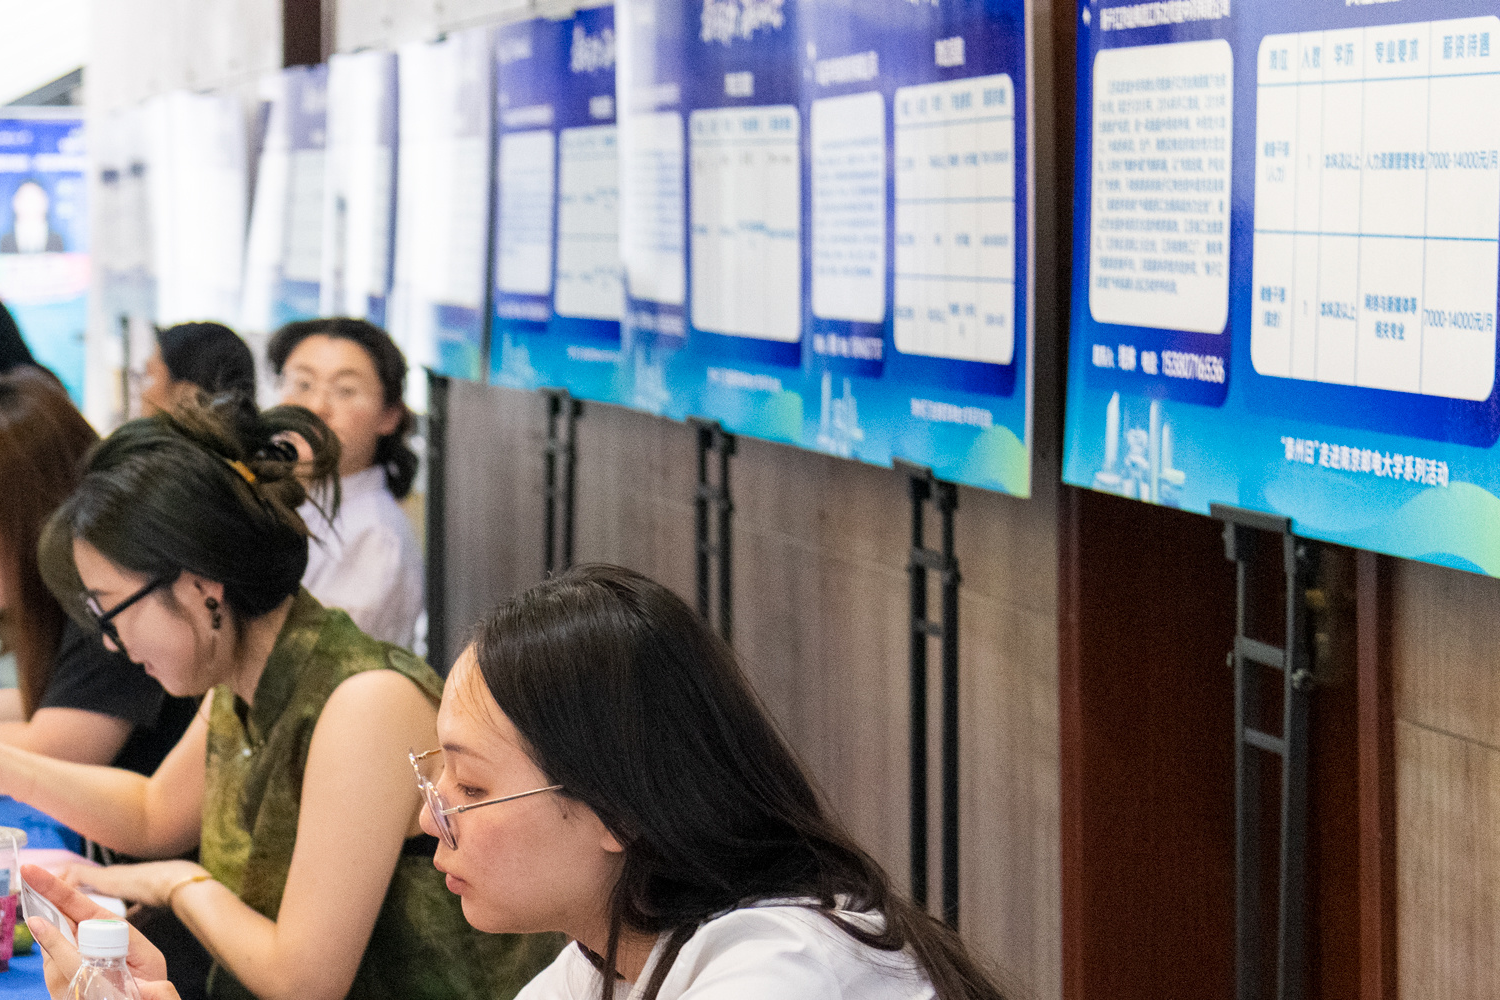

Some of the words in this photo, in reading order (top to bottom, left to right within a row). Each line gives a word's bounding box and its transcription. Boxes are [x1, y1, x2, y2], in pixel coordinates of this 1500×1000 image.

[1334, 43, 1354, 66] 学历
[1375, 38, 1419, 63] 专业要求
[1443, 32, 1490, 59] 薪资待遇
[1364, 152, 1425, 170] 人力资源管理专业
[1424, 309, 1493, 332] 7000-14000元/月
